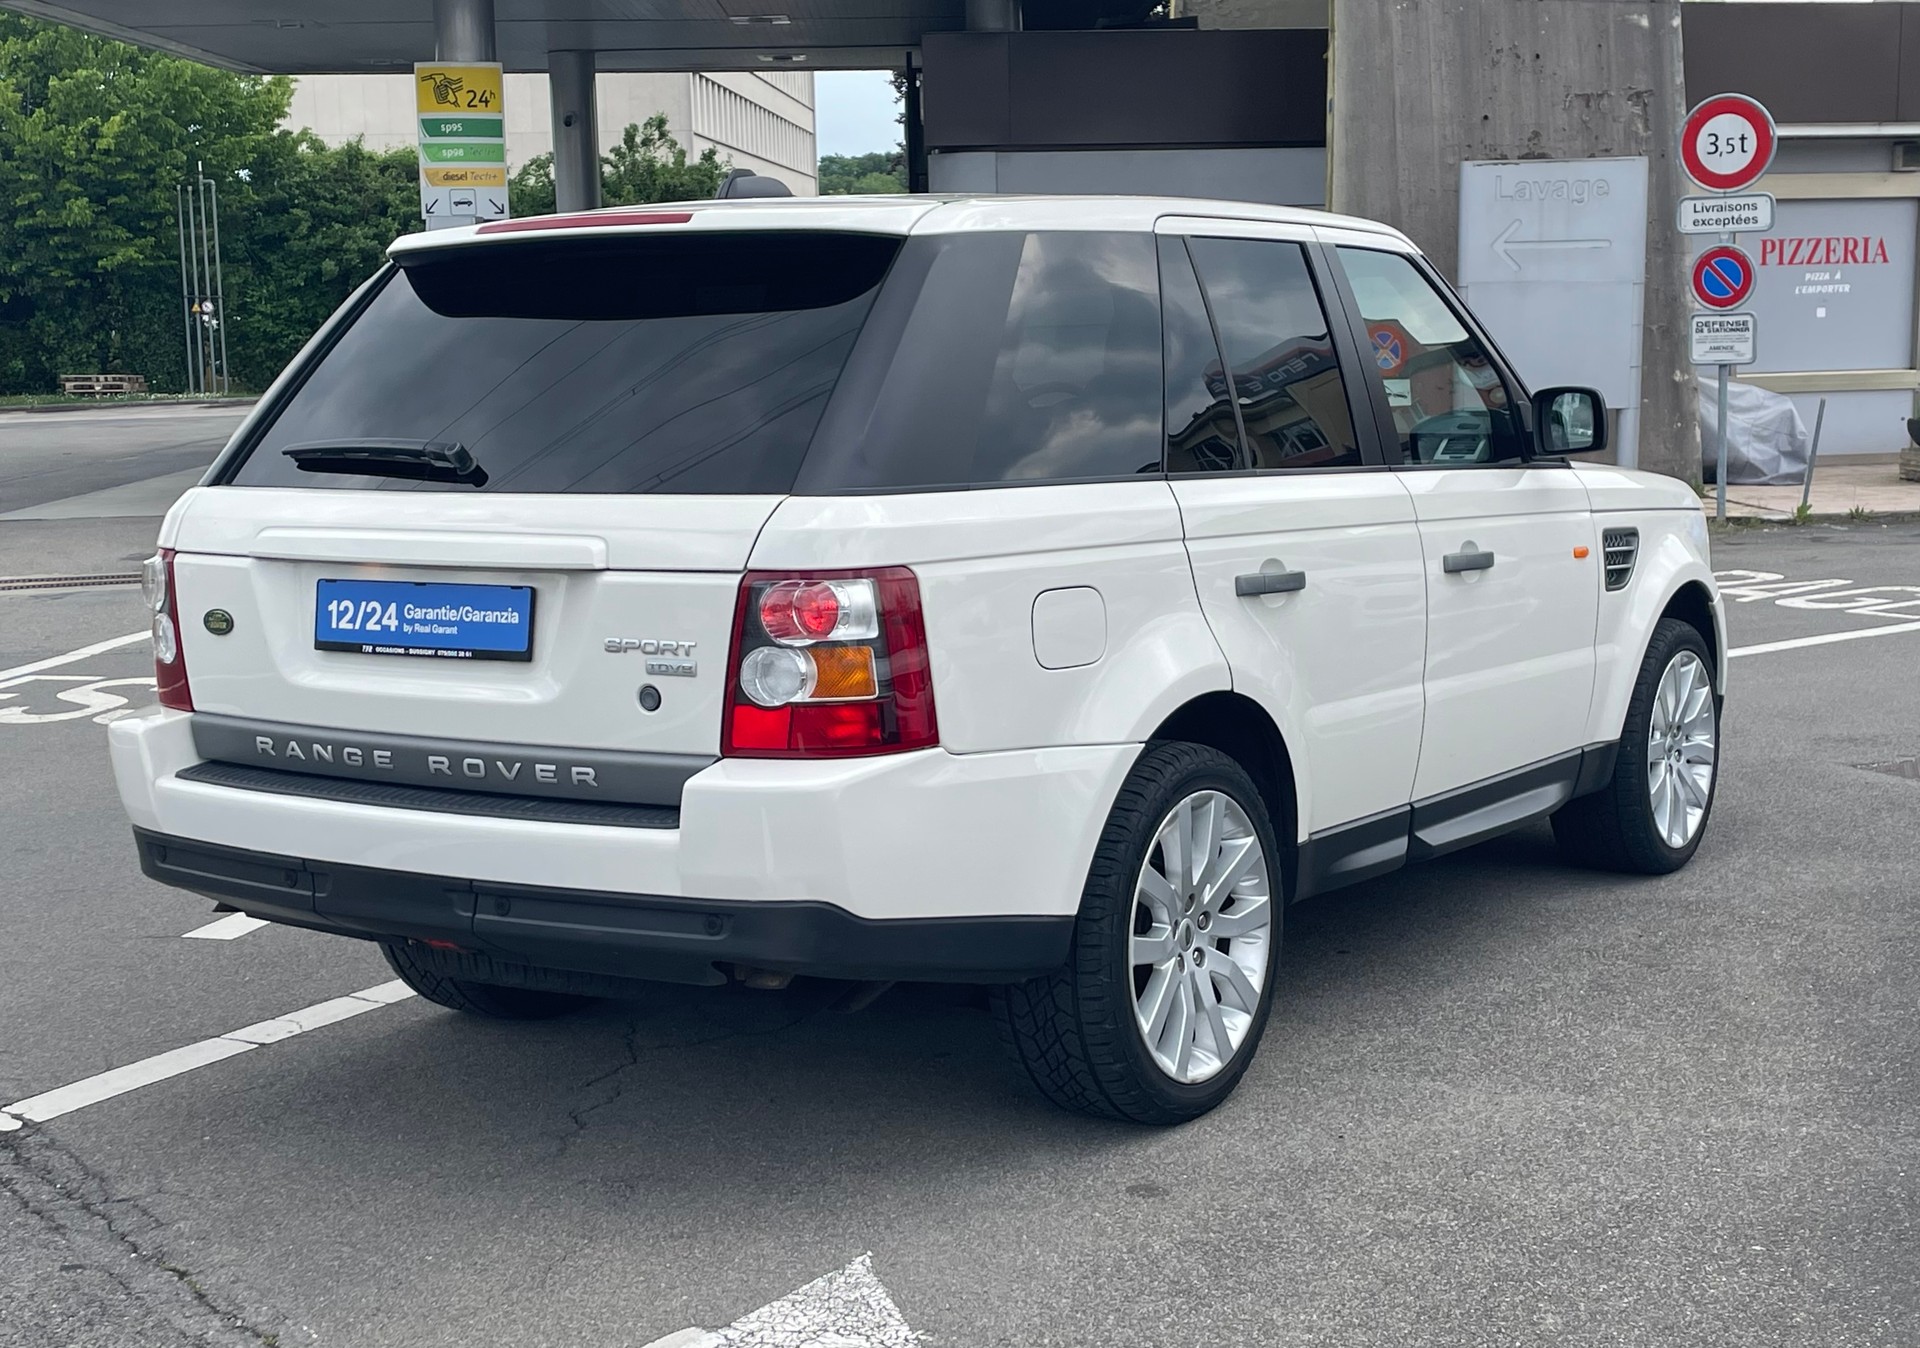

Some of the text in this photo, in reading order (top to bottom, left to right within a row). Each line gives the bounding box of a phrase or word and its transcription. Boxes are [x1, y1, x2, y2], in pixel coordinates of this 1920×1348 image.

[440, 123, 463, 134] sp95
[441, 148, 464, 159] sp98
[443, 171, 468, 181] diesel
[1494, 174, 1610, 205] Lavage
[1693, 201, 1758, 213] Livraisons
[1692, 214, 1759, 228] exceptées
[1760, 236, 1890, 266] PIZZERIA
[1805, 272, 1830, 281] PIZZA
[1795, 283, 1851, 294] L'EMPORTER
[1696, 320, 1749, 328] DEFENSE
[327, 599, 519, 632] 12/24 Garantie/Garanzia
[403, 623, 458, 635] by Real Garant
[604, 637, 697, 657] SPORT
[647, 662, 694, 674] TDV8
[255, 735, 598, 787] RANGE ROVER
